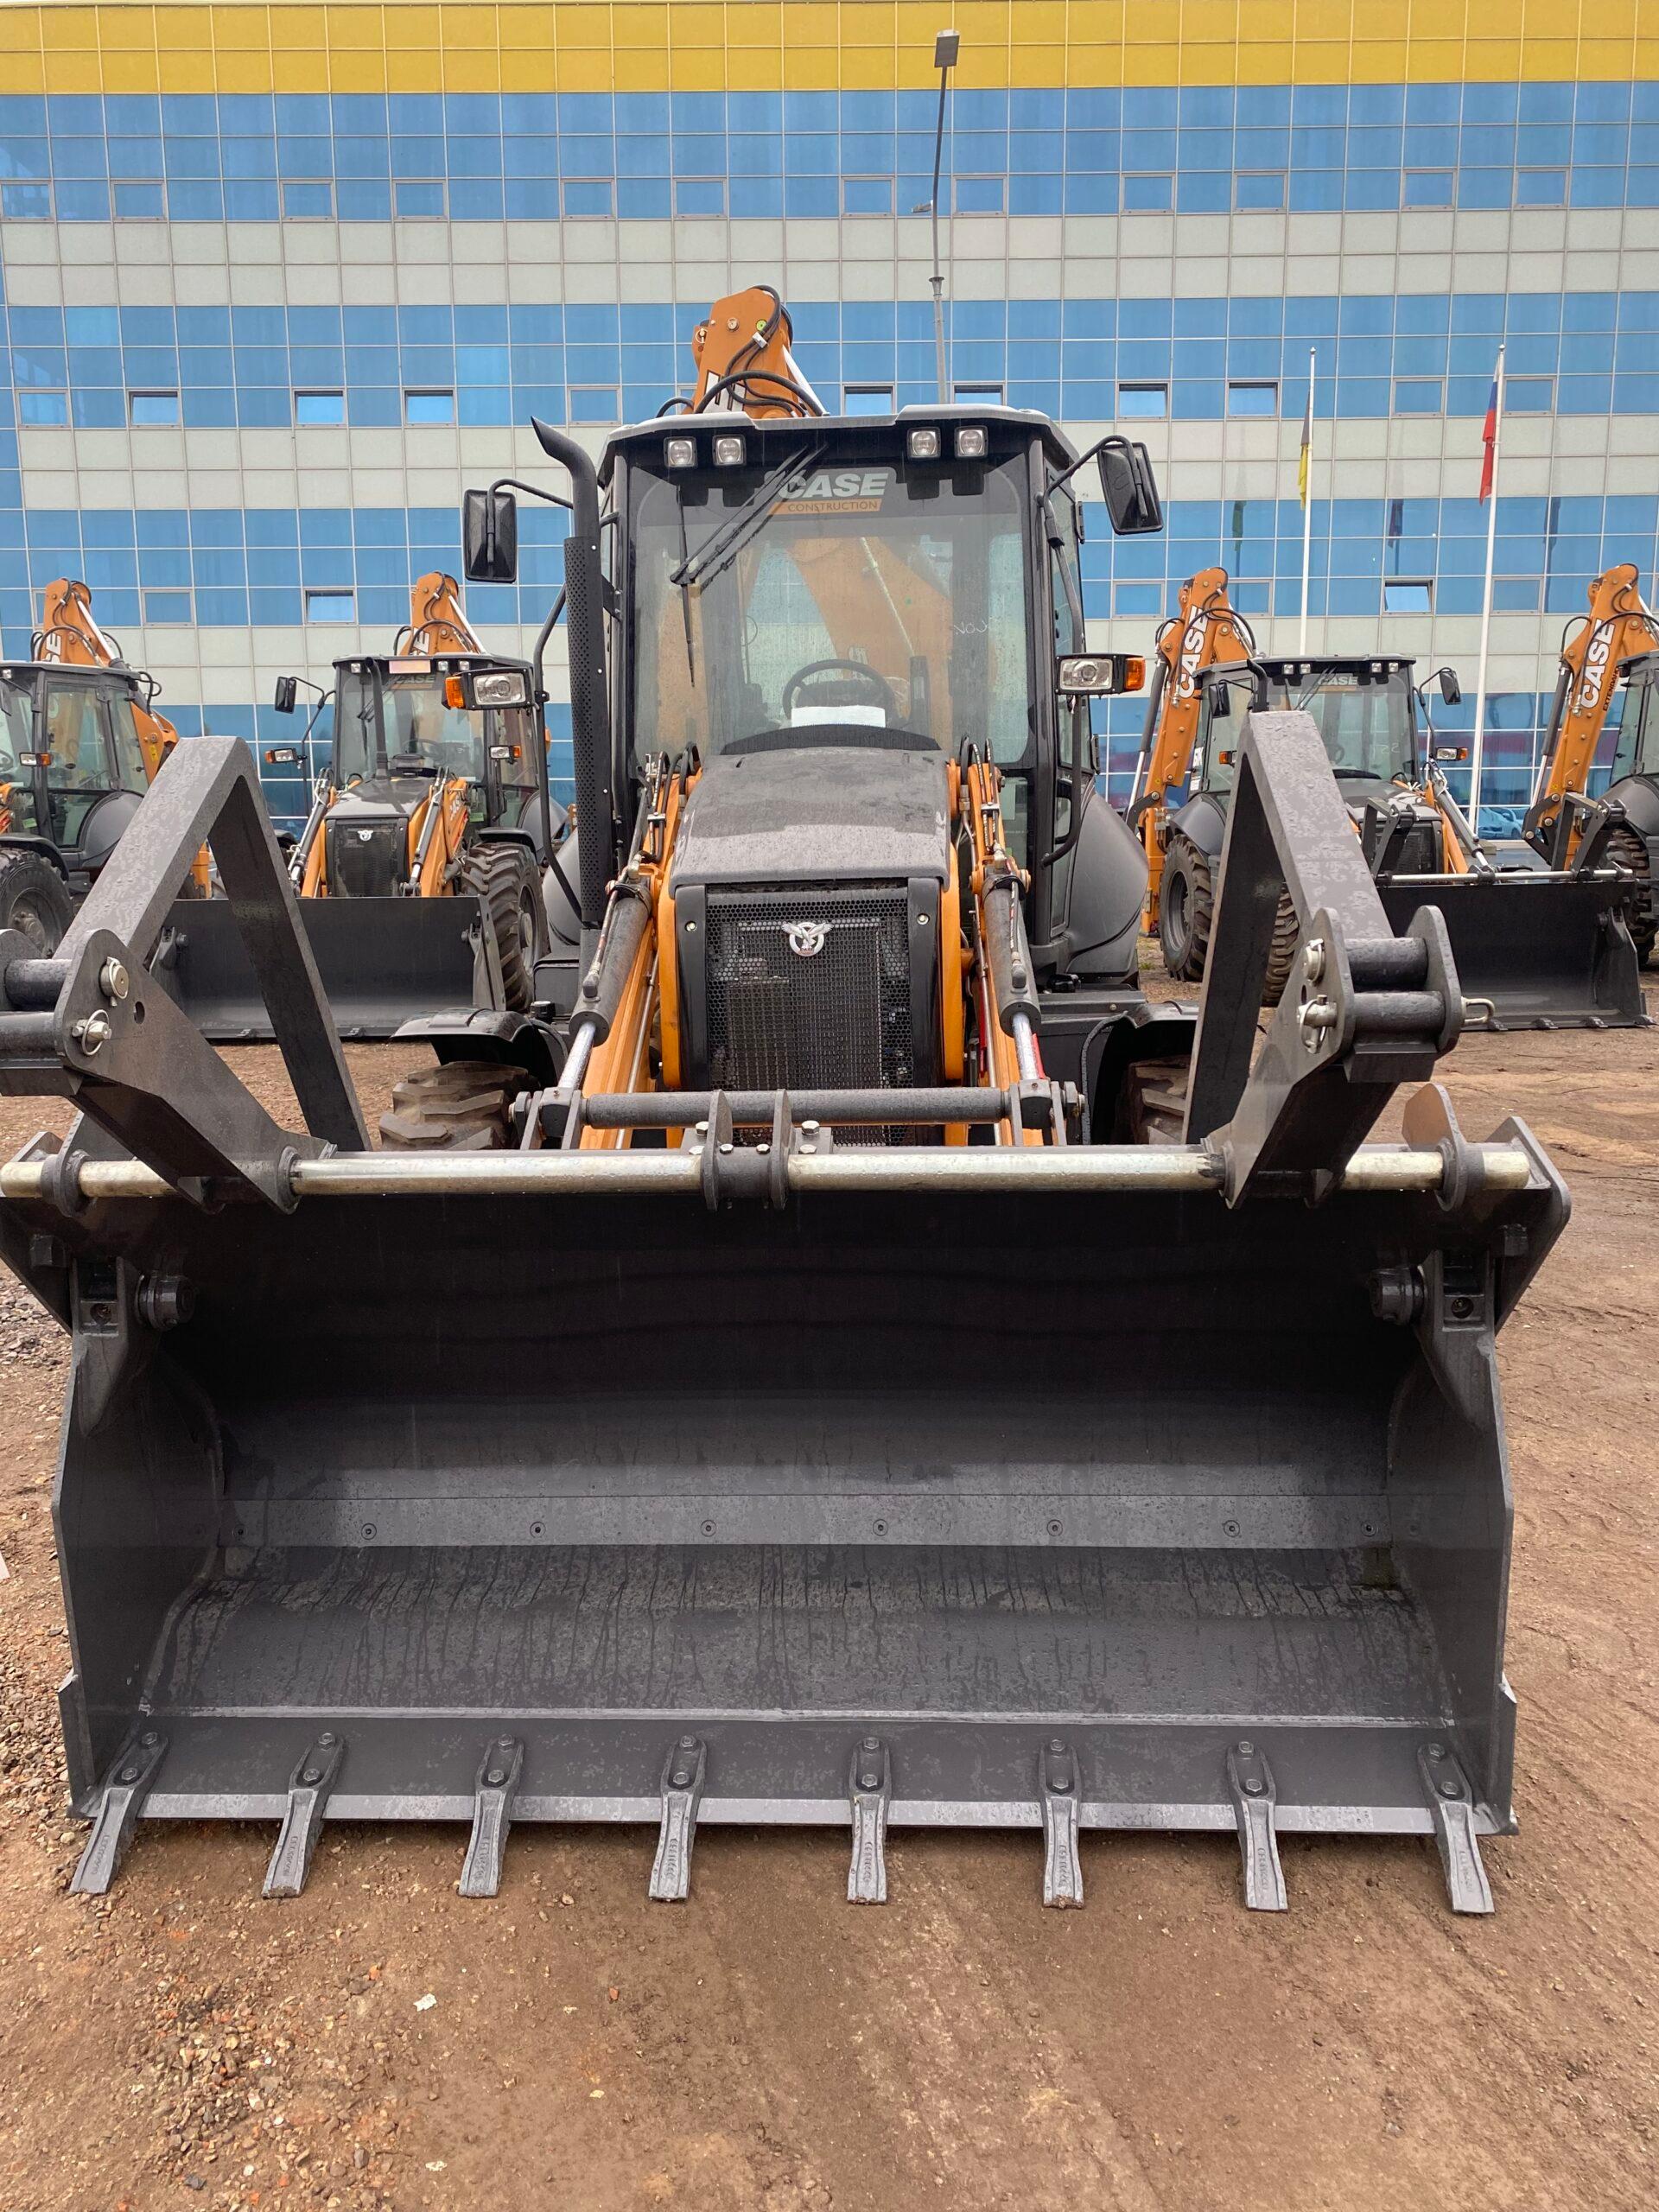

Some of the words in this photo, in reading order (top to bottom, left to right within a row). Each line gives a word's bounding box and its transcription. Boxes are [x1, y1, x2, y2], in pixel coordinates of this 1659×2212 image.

[778, 472, 888, 499] CASE
[787, 499, 878, 513] CONSTRUCTION
[1179, 604, 1209, 698] CASE
[1580, 618, 1616, 709] CASE
